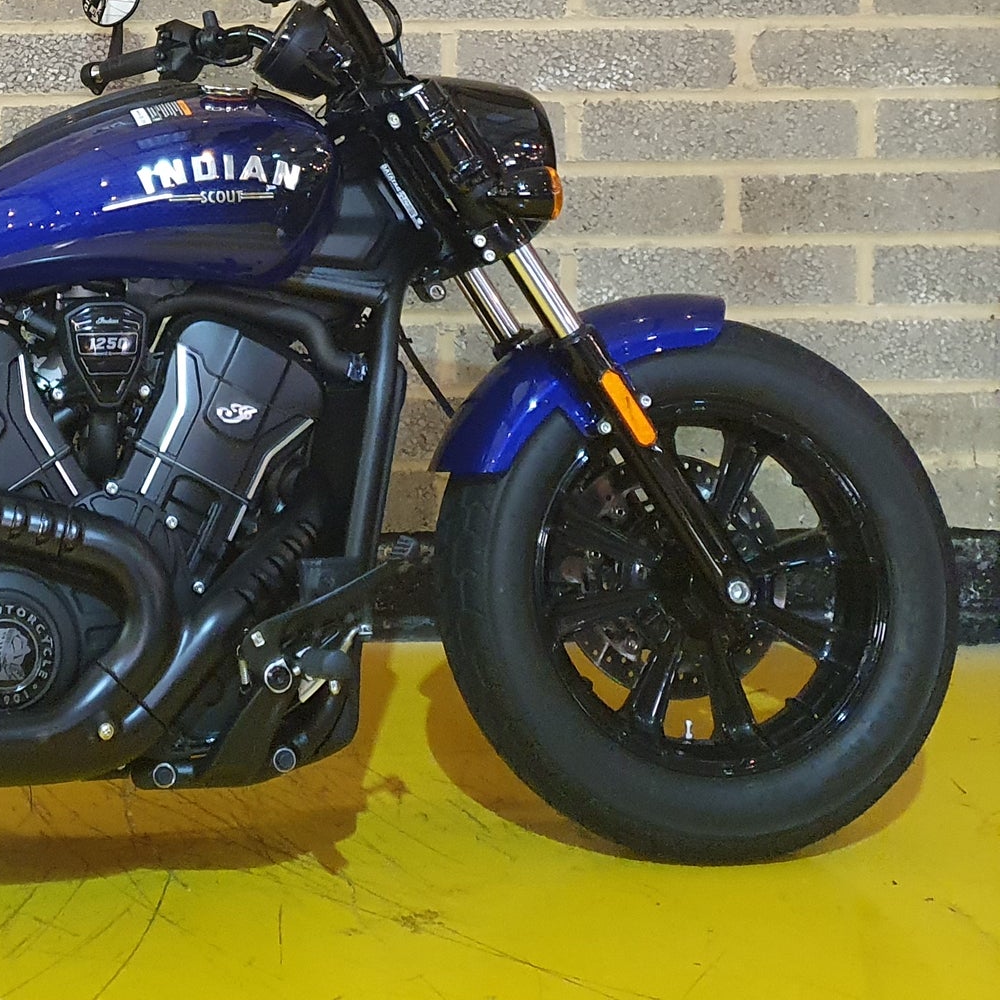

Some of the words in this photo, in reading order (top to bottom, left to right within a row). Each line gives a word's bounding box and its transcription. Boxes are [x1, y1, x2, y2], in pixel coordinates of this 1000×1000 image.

[136, 153, 301, 195] INDIAN
[200, 190, 243, 203] SCOUT
[89, 337, 129, 350] 1250
